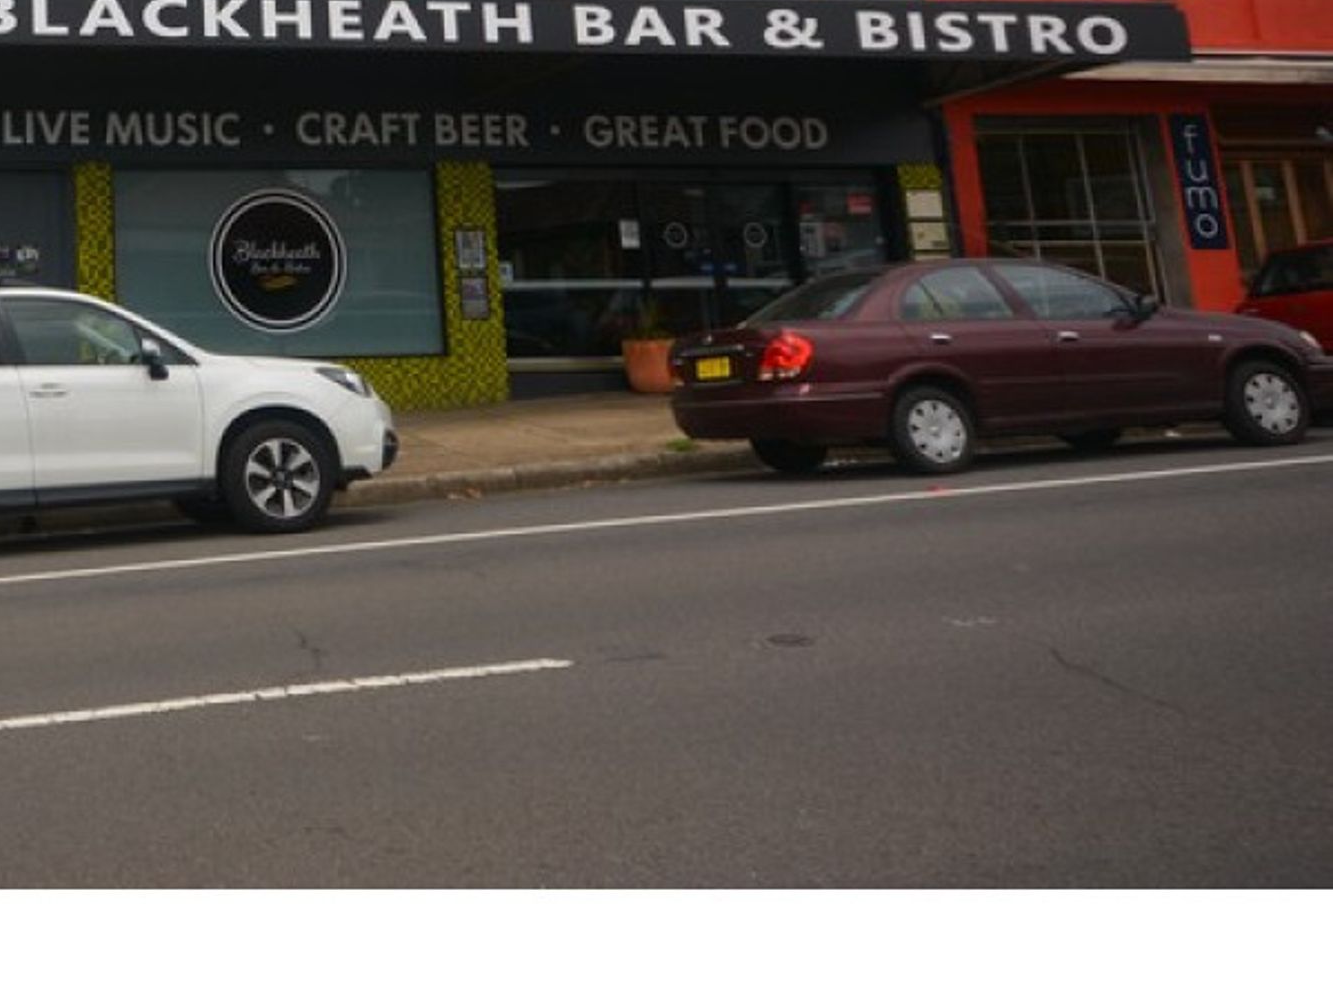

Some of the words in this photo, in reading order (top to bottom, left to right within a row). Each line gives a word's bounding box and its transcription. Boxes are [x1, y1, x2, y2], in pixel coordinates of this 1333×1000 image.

[574, 5, 730, 47] BAR
[763, 8, 824, 48] &
[855, 10, 1129, 56] BISTRO
[1, 110, 90, 146] LIVE
[106, 111, 241, 147] MUSIC
[295, 112, 423, 147] CRAFT
[435, 113, 530, 148] BEER
[584, 114, 708, 148] GREAT
[719, 116, 828, 150] FOOD
[1182, 124, 1220, 240] fumo
